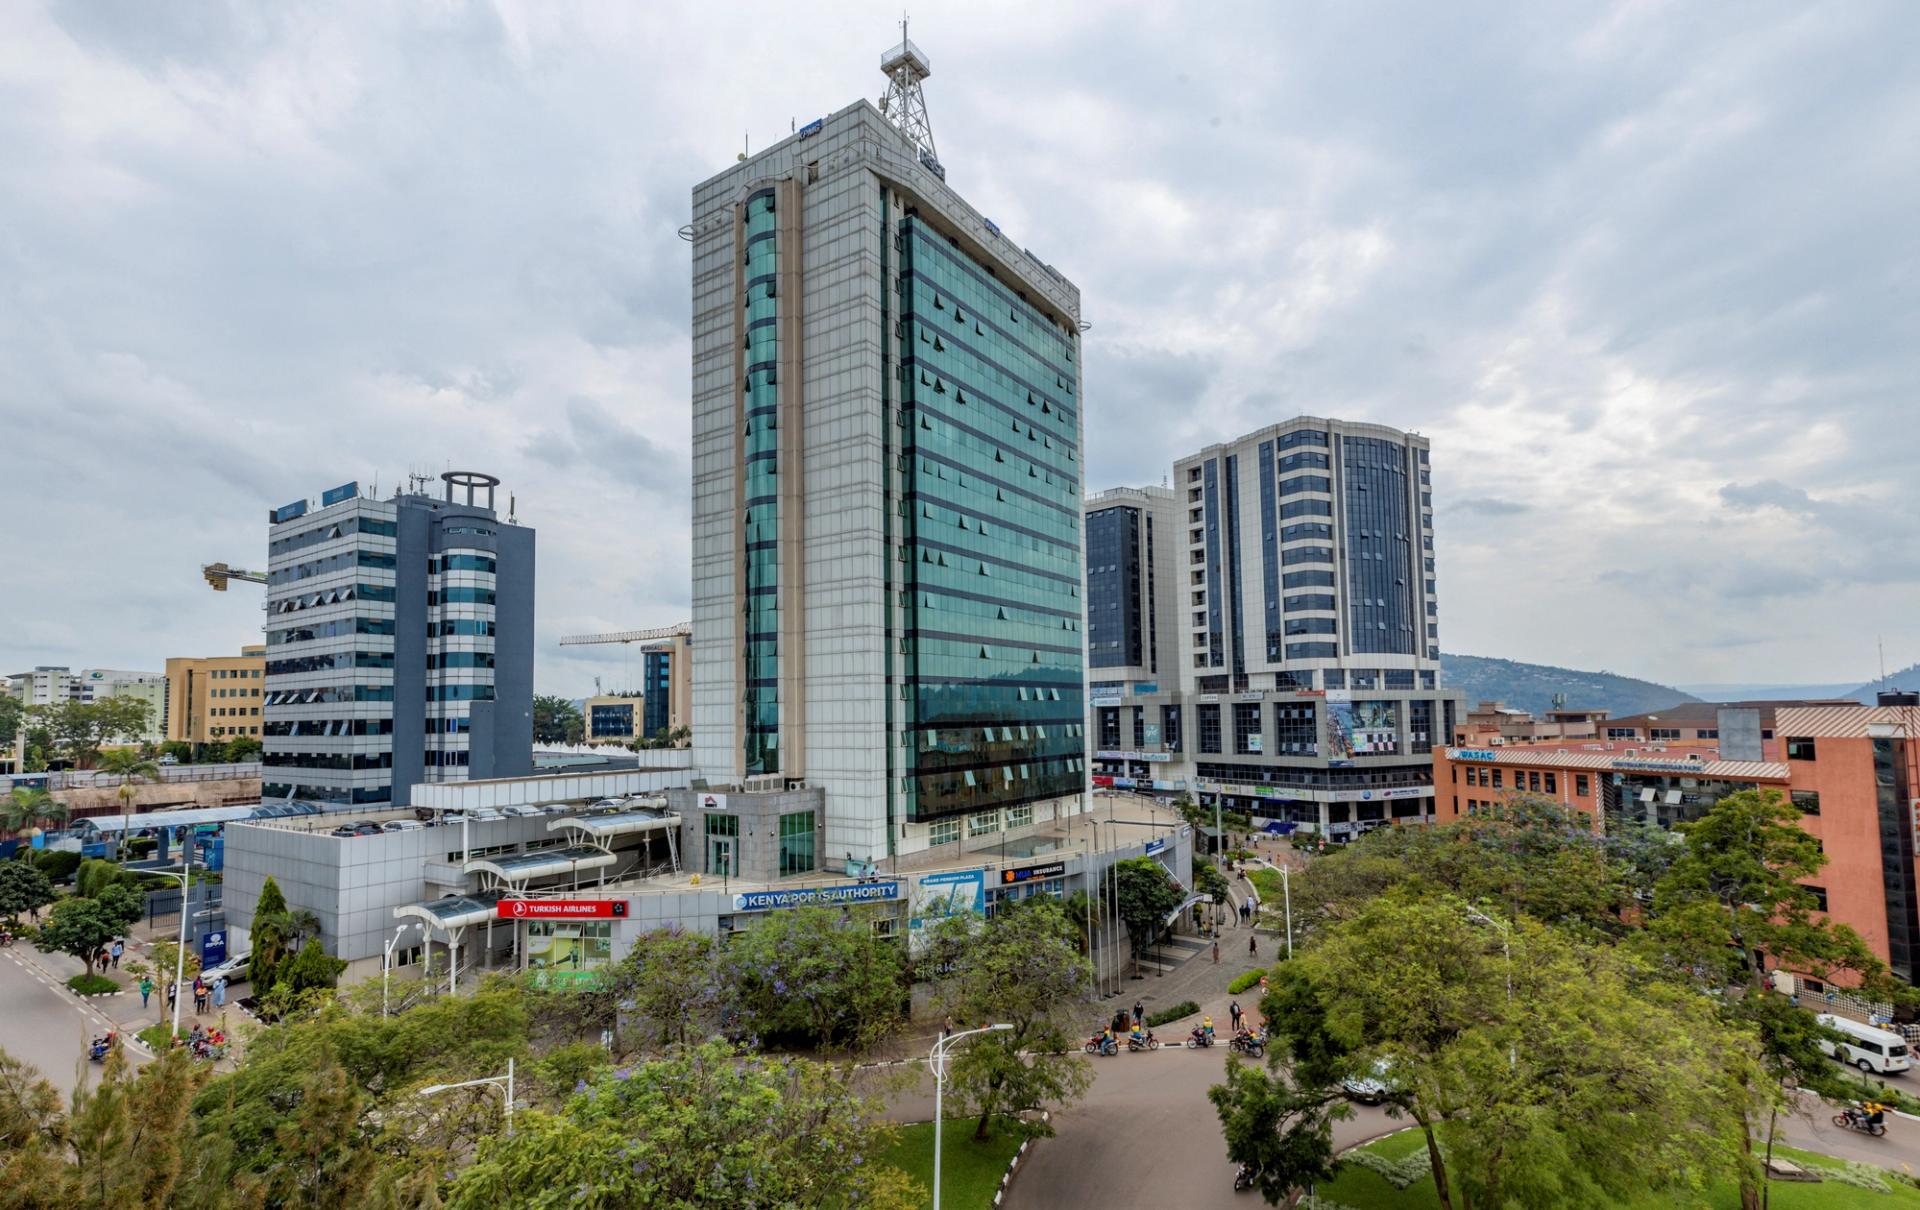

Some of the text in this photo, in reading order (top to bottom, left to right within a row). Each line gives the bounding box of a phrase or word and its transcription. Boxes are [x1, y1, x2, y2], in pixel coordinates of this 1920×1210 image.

[1461, 751, 1493, 760] WASAC
[1016, 870, 1032, 879] MUA
[1033, 865, 1063, 875] INSURANCE
[749, 894, 788, 906] KENYA
[832, 885, 896, 900] AUTHORITY
